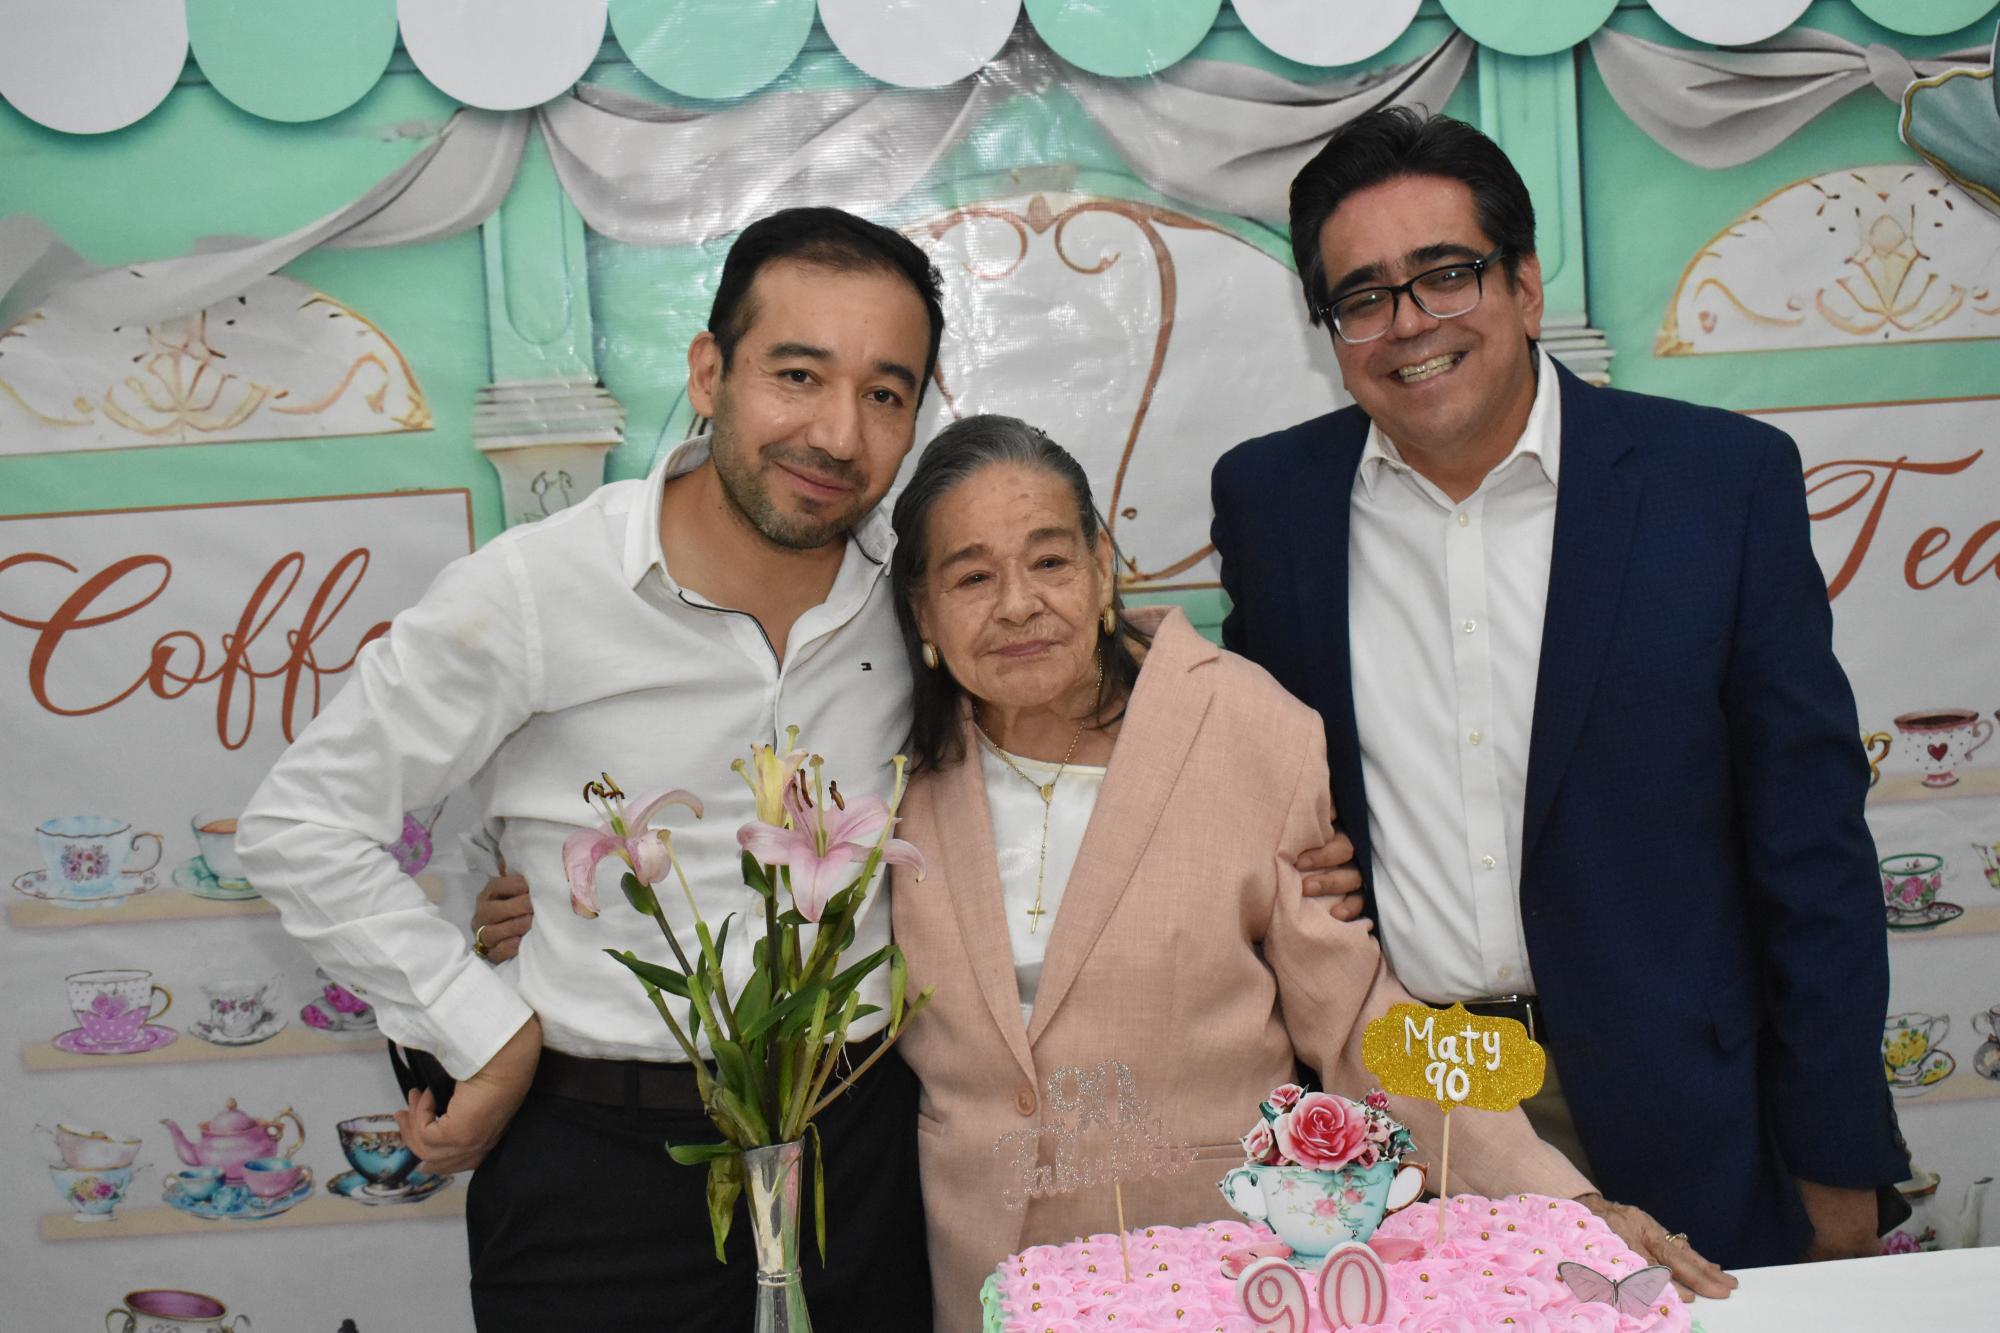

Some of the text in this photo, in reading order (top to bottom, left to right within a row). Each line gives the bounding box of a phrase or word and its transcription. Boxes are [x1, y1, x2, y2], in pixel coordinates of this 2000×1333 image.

[0, 547, 393, 751] Coff
[1404, 1015, 1501, 1071] Maty
[1425, 1061, 1470, 1101] 90
[1235, 1241, 1389, 1333] 90
